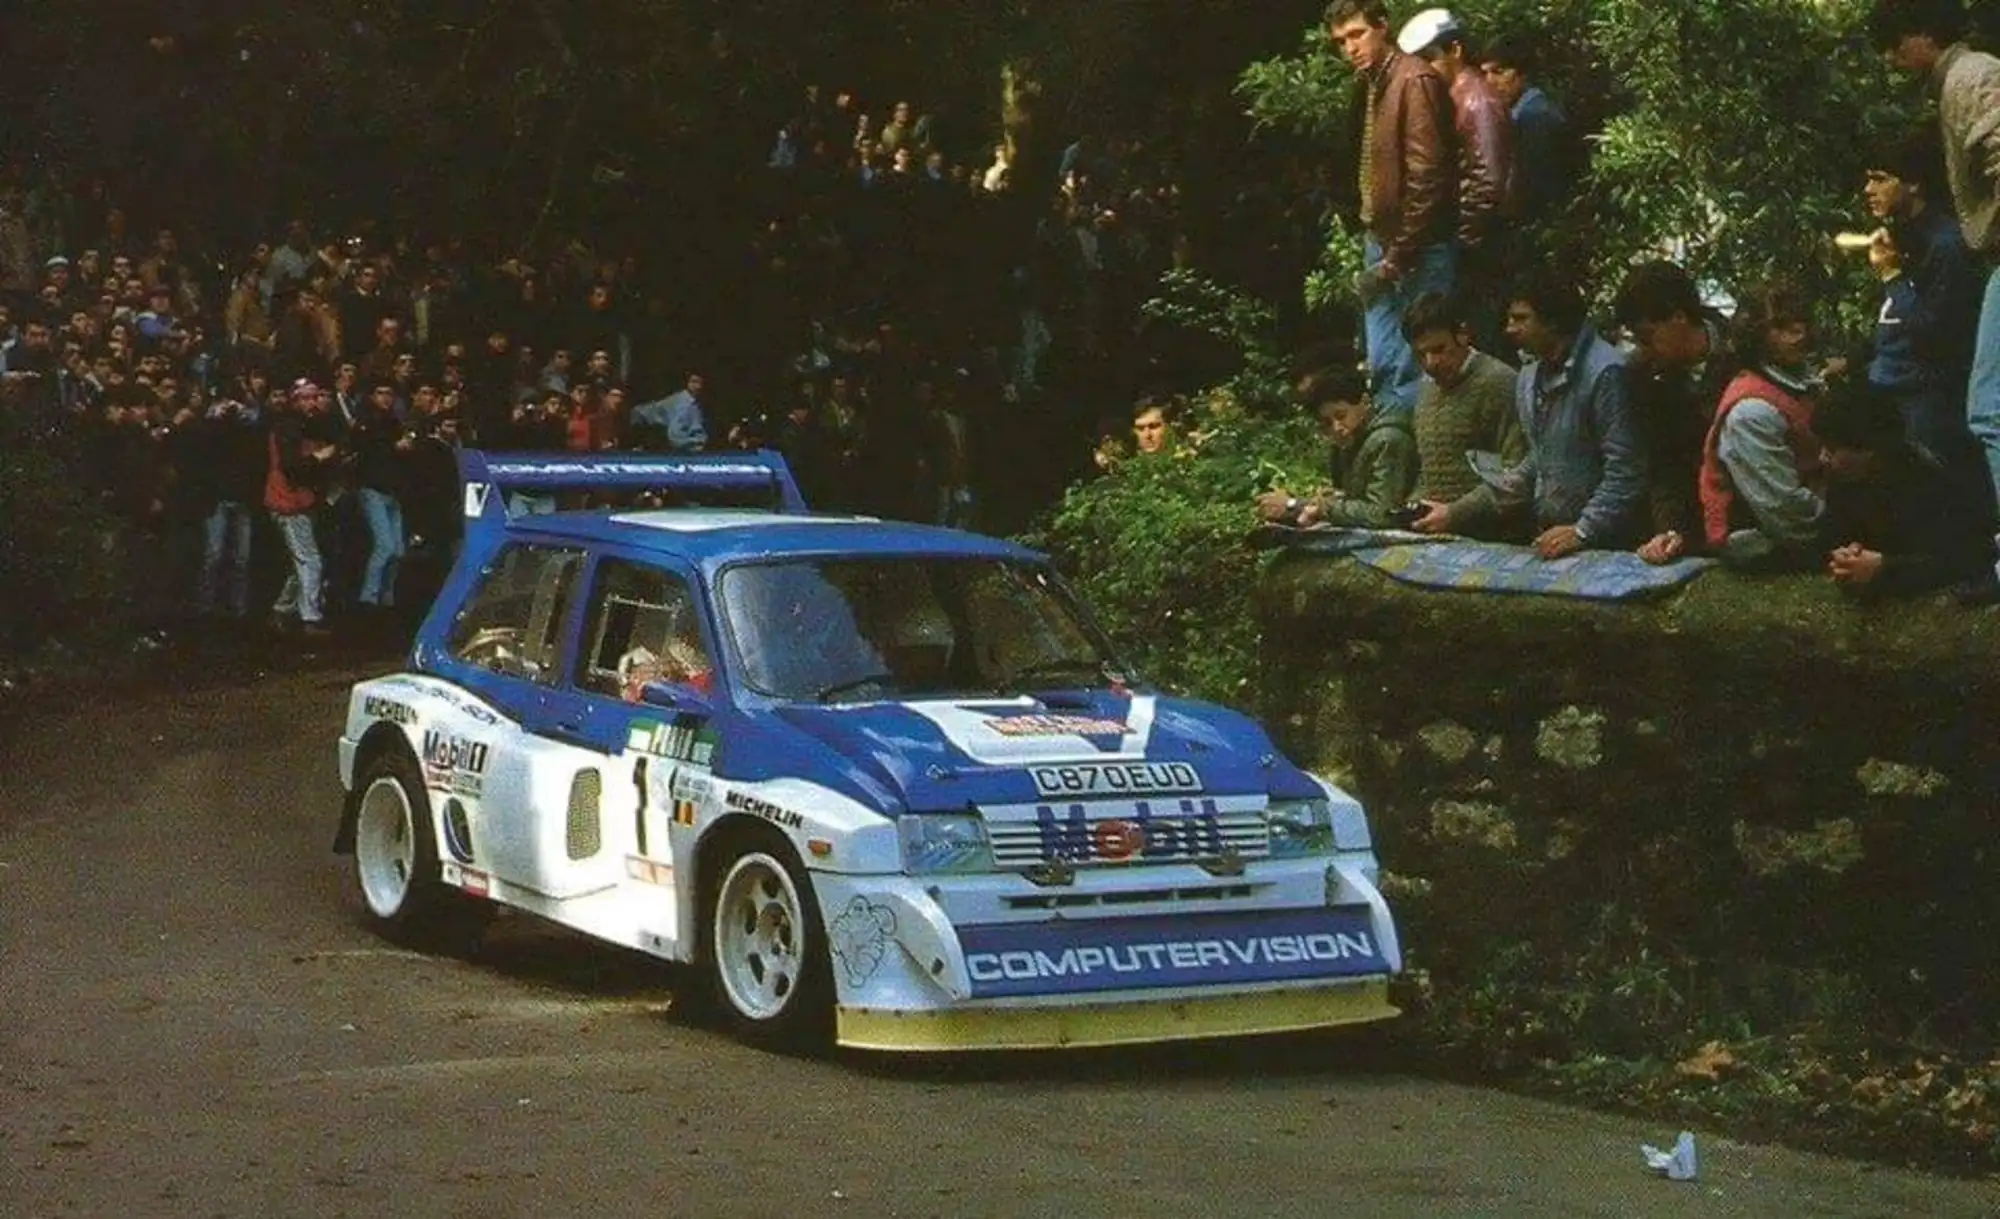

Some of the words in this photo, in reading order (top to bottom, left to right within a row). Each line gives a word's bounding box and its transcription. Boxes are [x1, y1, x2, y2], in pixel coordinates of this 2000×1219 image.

[1036, 763, 1194, 791] C870EUD
[726, 788, 804, 830] MICHELIN
[967, 932, 1373, 982] COMPUTERVISION
